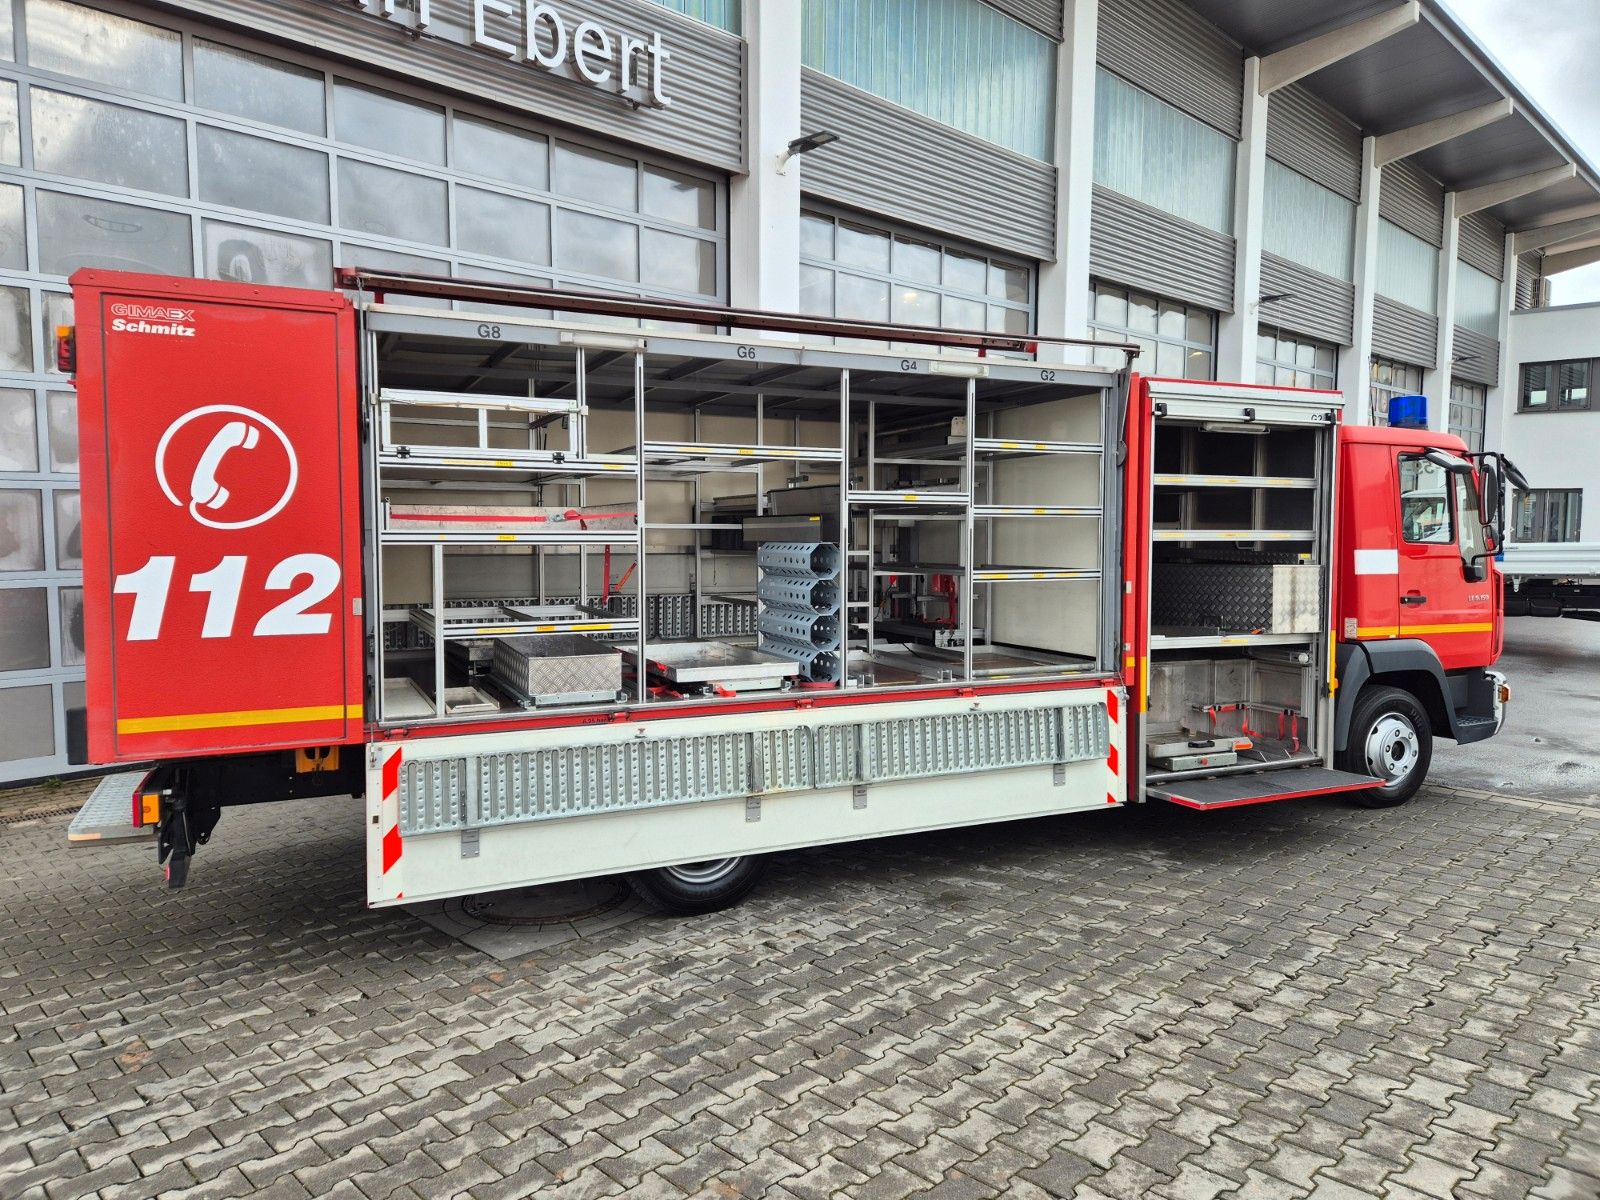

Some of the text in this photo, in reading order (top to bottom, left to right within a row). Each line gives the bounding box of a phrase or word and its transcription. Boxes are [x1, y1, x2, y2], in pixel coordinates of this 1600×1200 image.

[472, 0, 672, 108] Ebert
[110, 303, 196, 322] GIMAEX
[111, 318, 196, 337] Schmitz
[477, 323, 501, 340] G8
[736, 345, 756, 360] G6
[900, 359, 918, 372] G4
[1040, 370, 1056, 382] G2
[113, 552, 342, 642] 112
